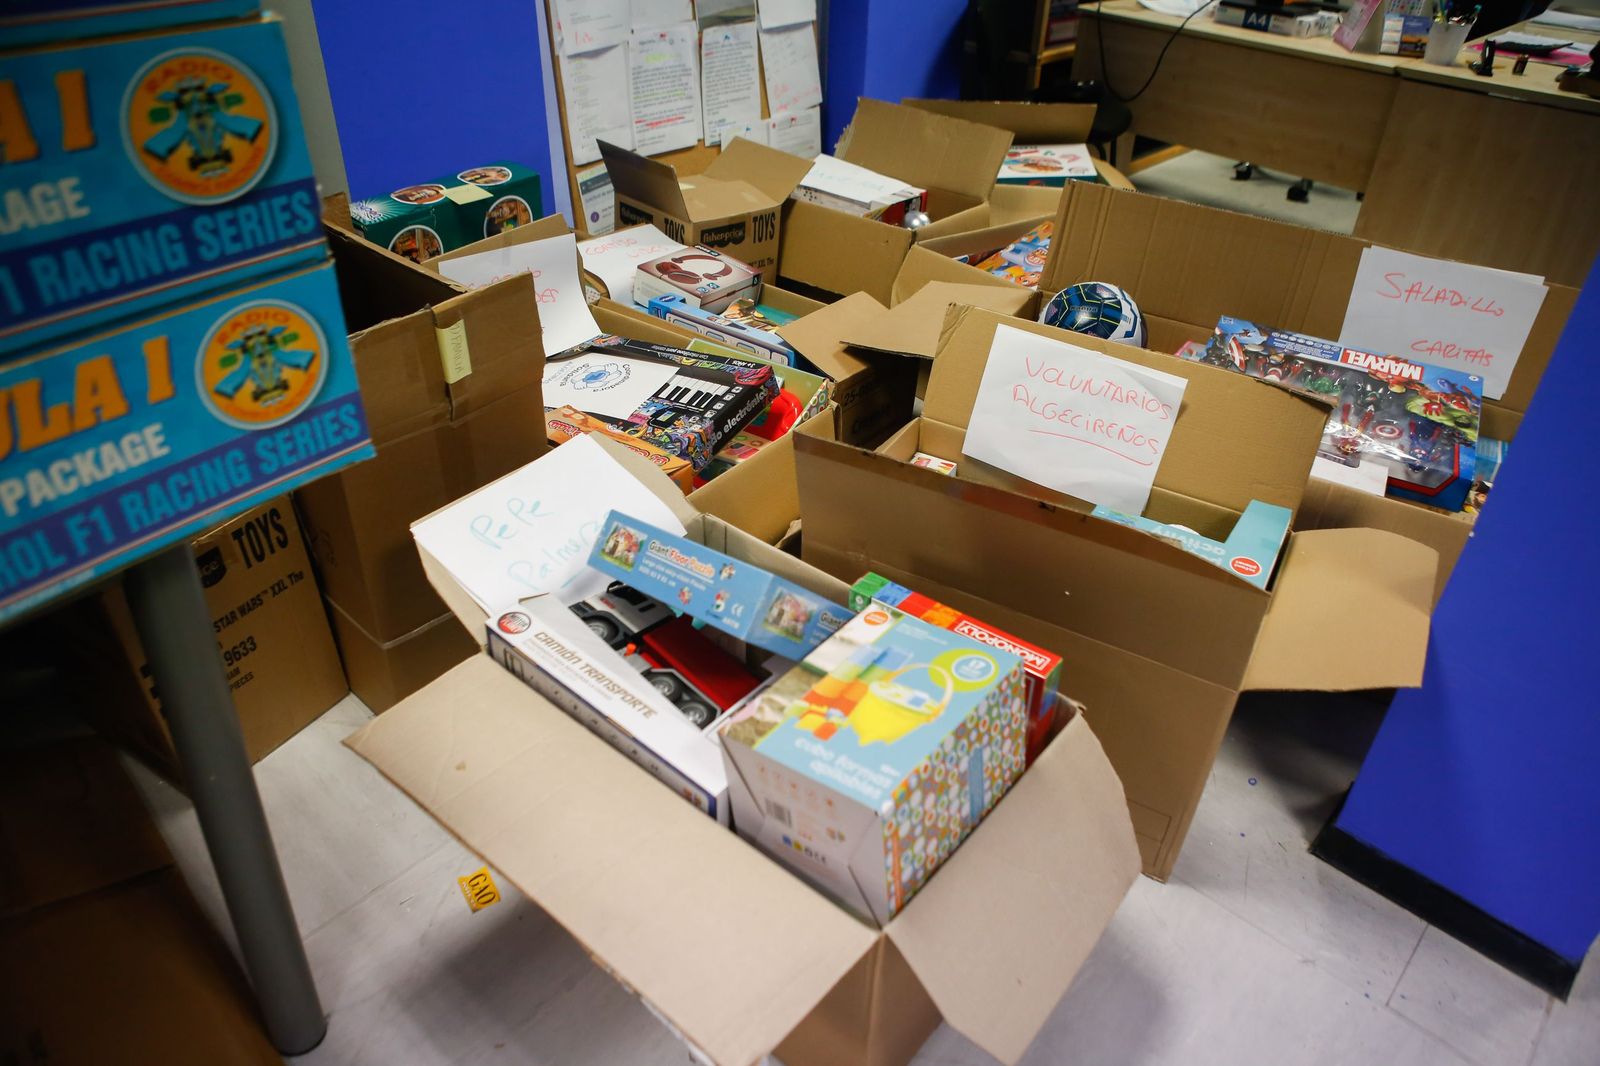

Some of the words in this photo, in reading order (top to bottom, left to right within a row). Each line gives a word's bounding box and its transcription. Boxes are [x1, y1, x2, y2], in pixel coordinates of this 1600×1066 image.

[1247, 13, 1267, 27] A4
[30, 223, 190, 306] RACING
[193, 191, 317, 262] SERIES
[752, 211, 777, 244] TOYS
[1346, 350, 1422, 381] MARVEL
[1411, 340, 1495, 367] CARITAS
[1, 423, 172, 518] PACKAGE
[65, 504, 117, 556] F1
[118, 453, 254, 534] RACING
[254, 403, 361, 475] SERIES
[232, 508, 289, 570] TOYS
[213, 609, 239, 633] STAR
[270, 581, 287, 598] XXL
[287, 570, 304, 587] The
[958, 622, 1047, 669] MONOPOLY
